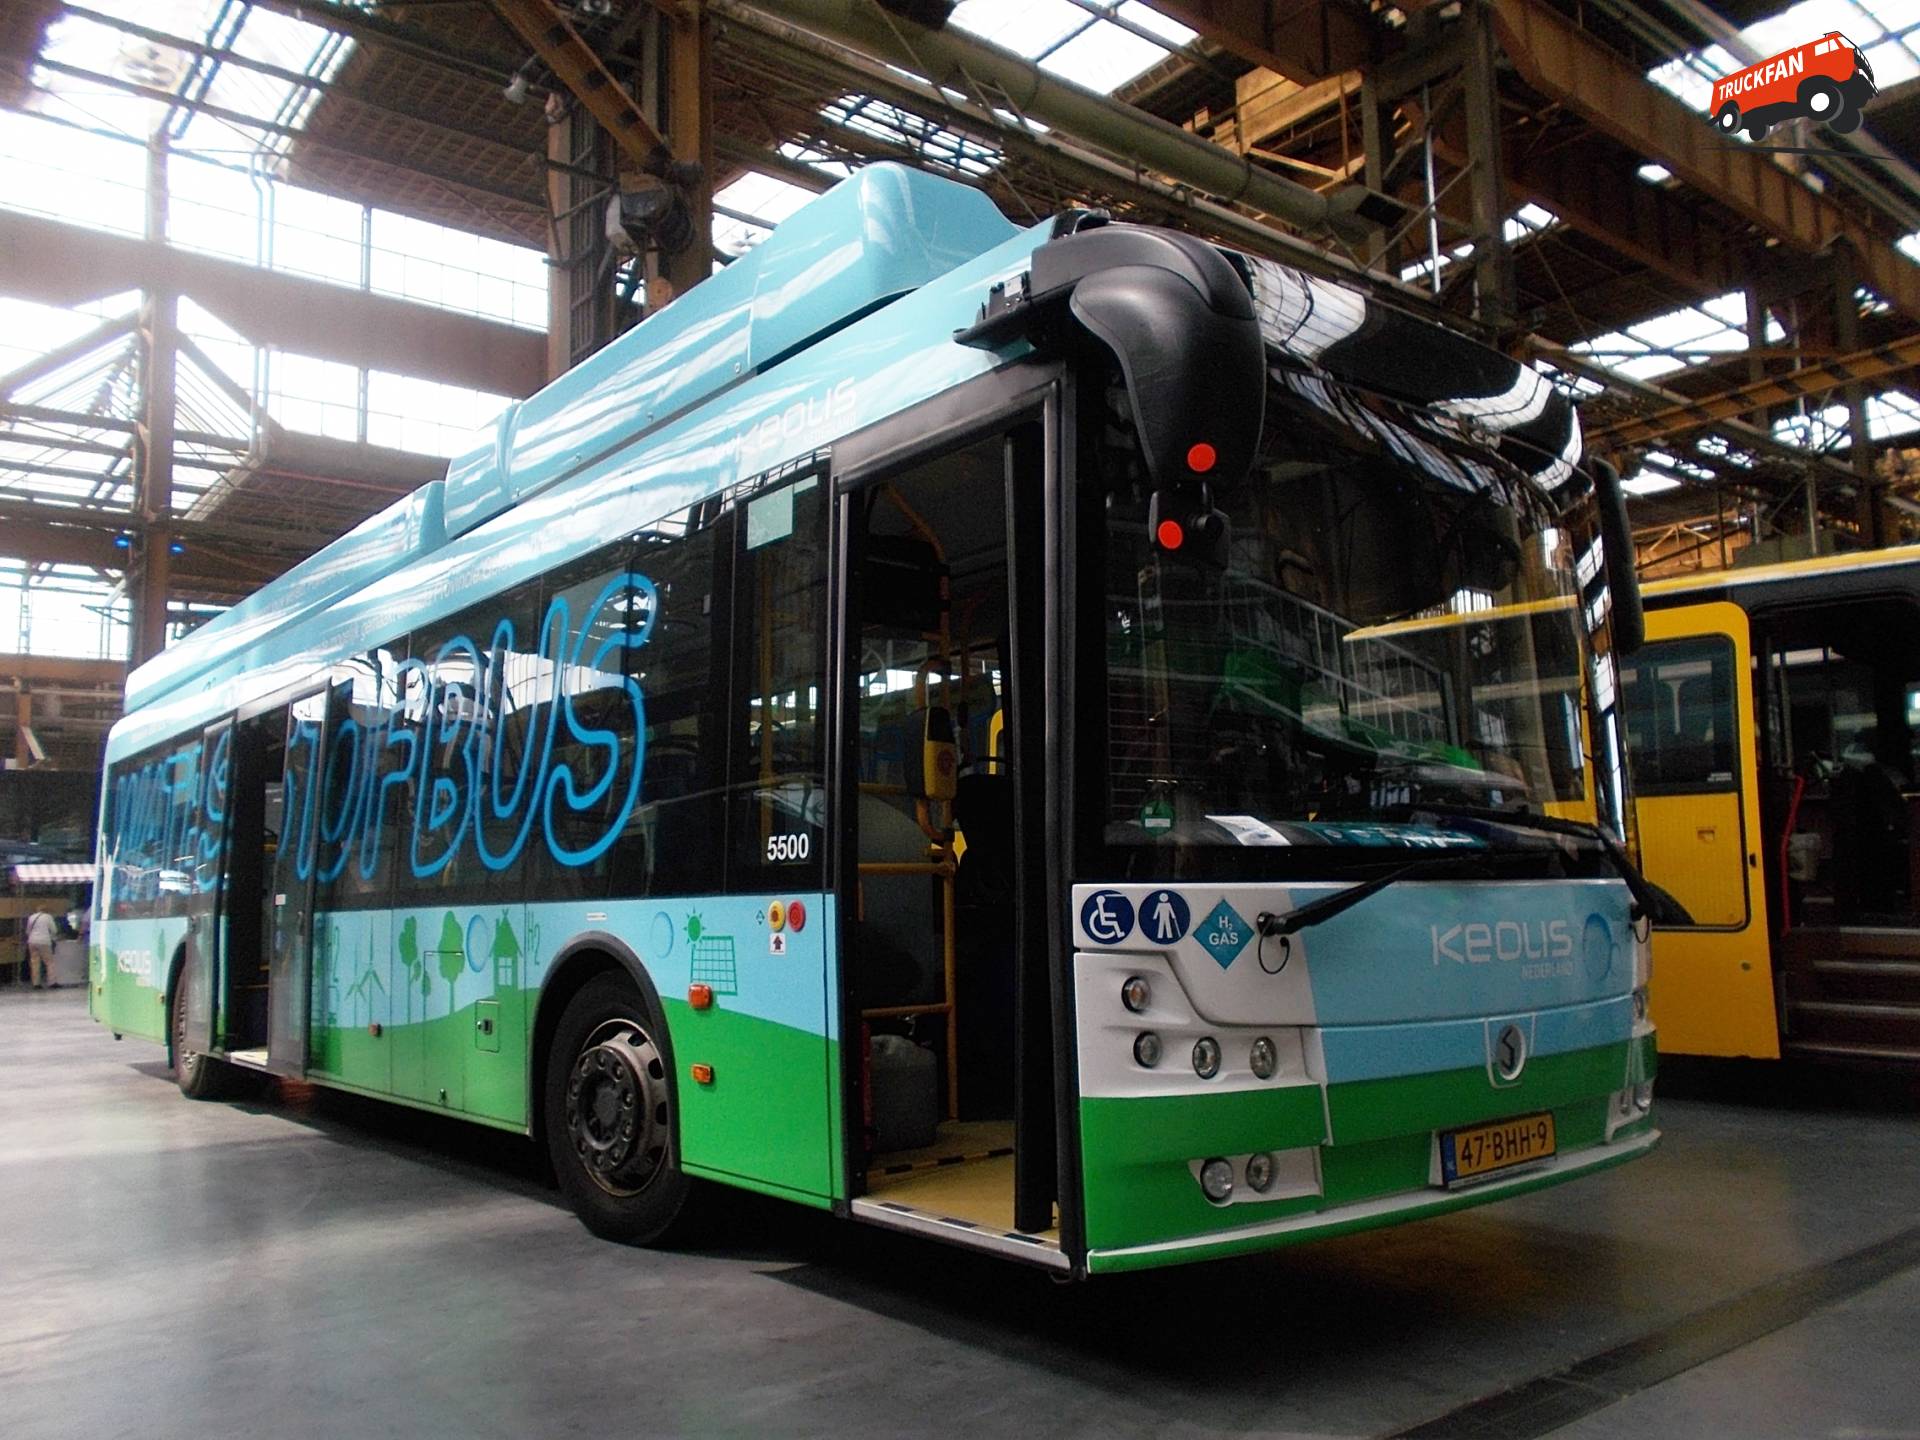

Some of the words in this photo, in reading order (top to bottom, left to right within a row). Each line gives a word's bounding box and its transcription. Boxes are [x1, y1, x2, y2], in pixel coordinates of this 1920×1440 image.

[766, 833, 810, 861] 5500
[1208, 931, 1239, 946] GAS
[1461, 1120, 1548, 1169] 47-BHH-9
